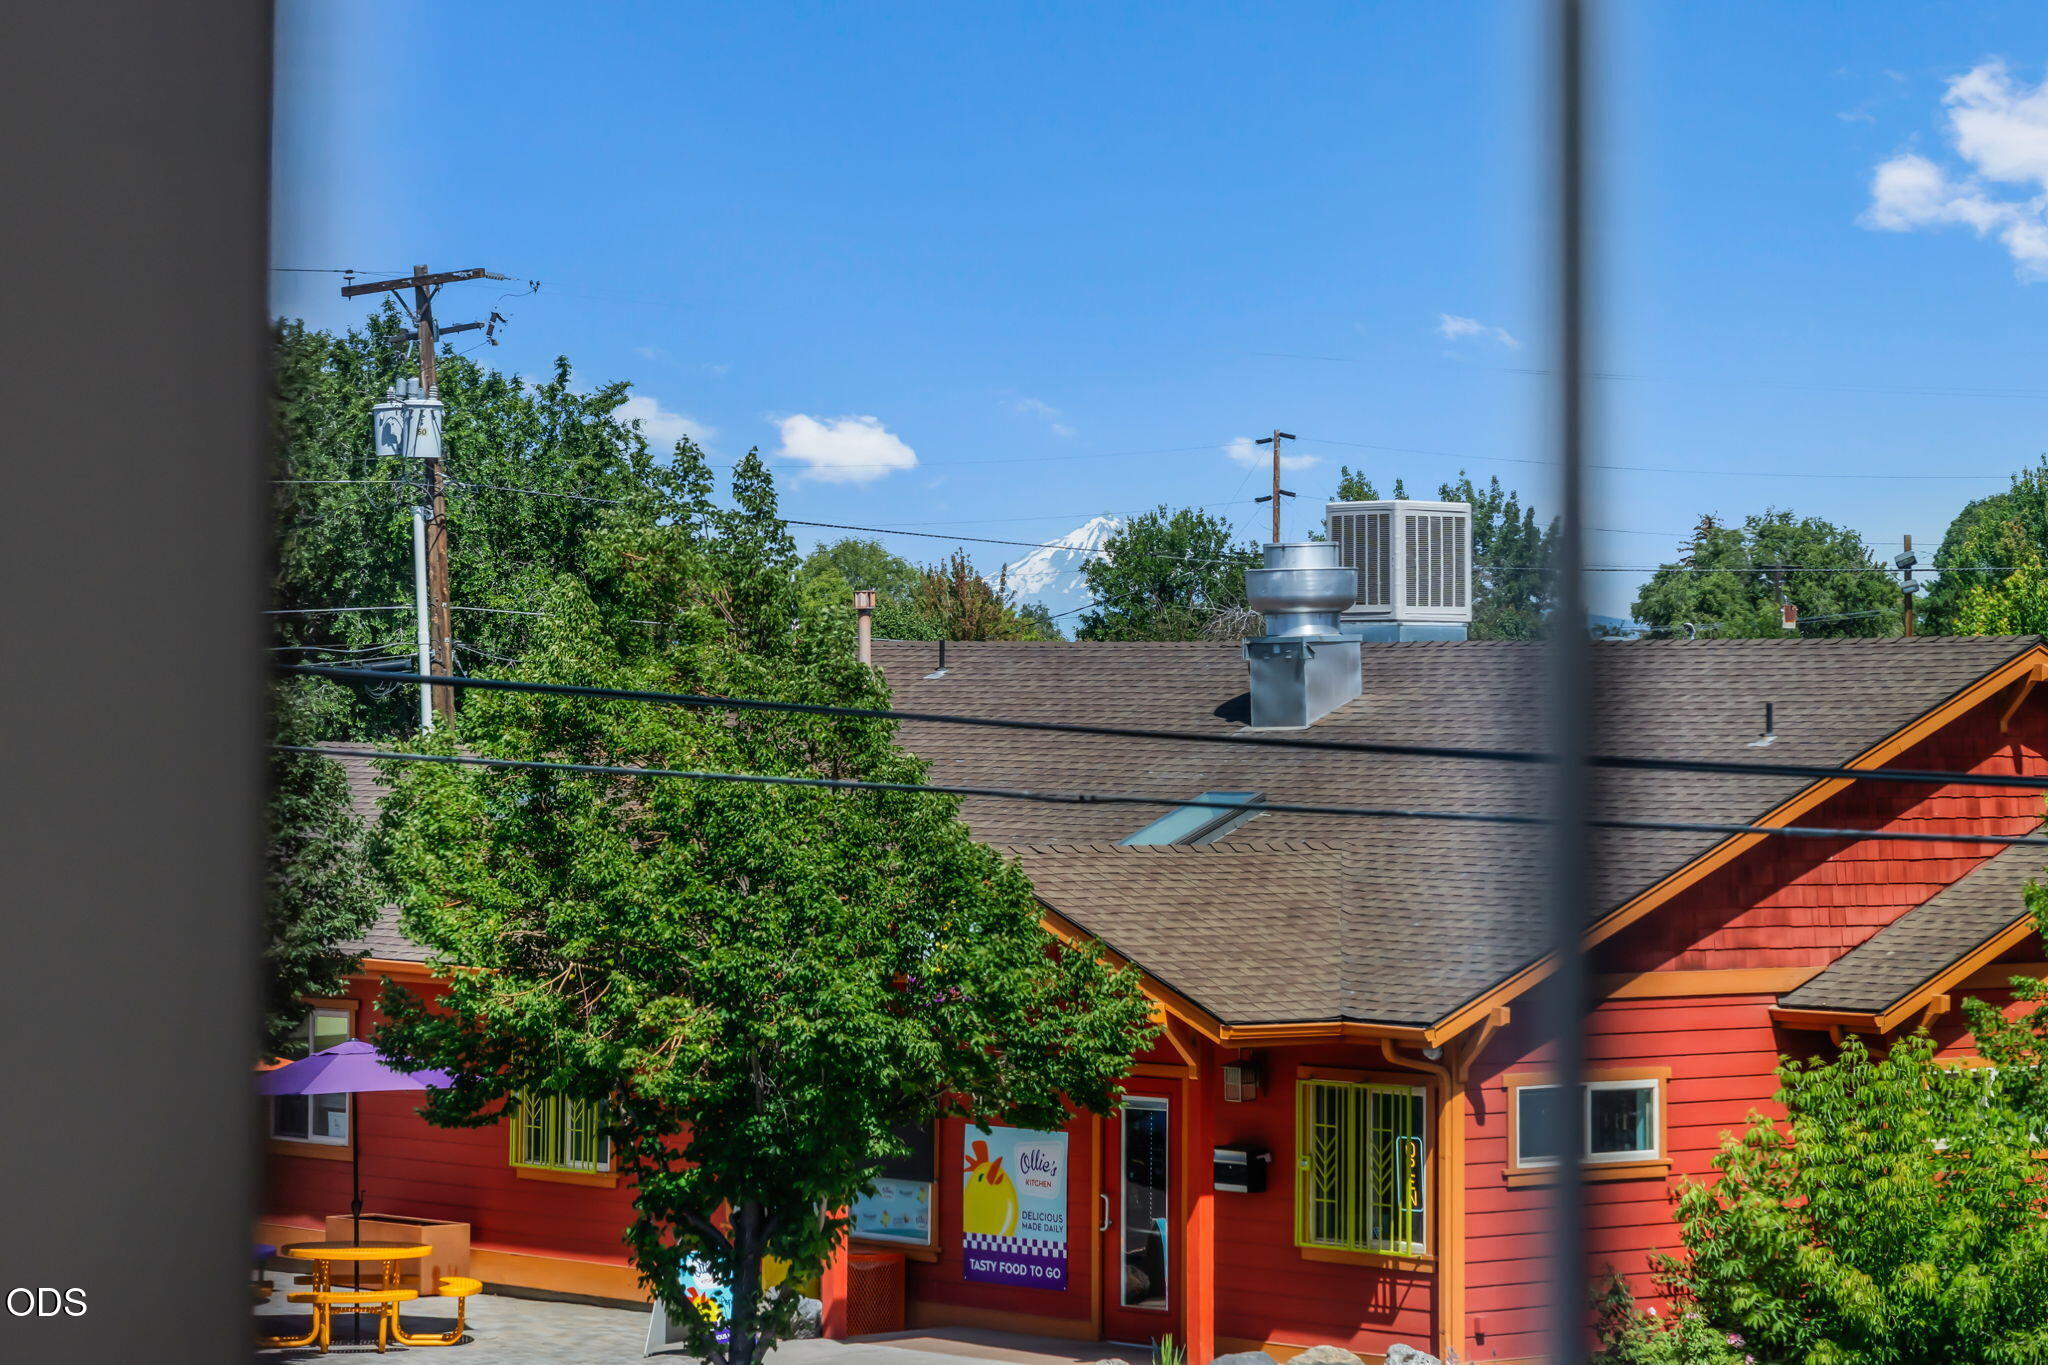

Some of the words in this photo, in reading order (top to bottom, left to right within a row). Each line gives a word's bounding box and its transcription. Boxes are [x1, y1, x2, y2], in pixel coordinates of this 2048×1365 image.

[1020, 1149, 1058, 1177] Ollie's
[1025, 1178, 1052, 1188] KITCHEN
[1021, 1210, 1064, 1224] DELICIOUS
[1021, 1222, 1042, 1232] MADE
[1043, 1223, 1064, 1233] DAILY
[969, 1258, 997, 1272] TASTY
[999, 1261, 1027, 1276] FOOD
[1030, 1265, 1043, 1278] TO
[1045, 1266, 1061, 1279] GO
